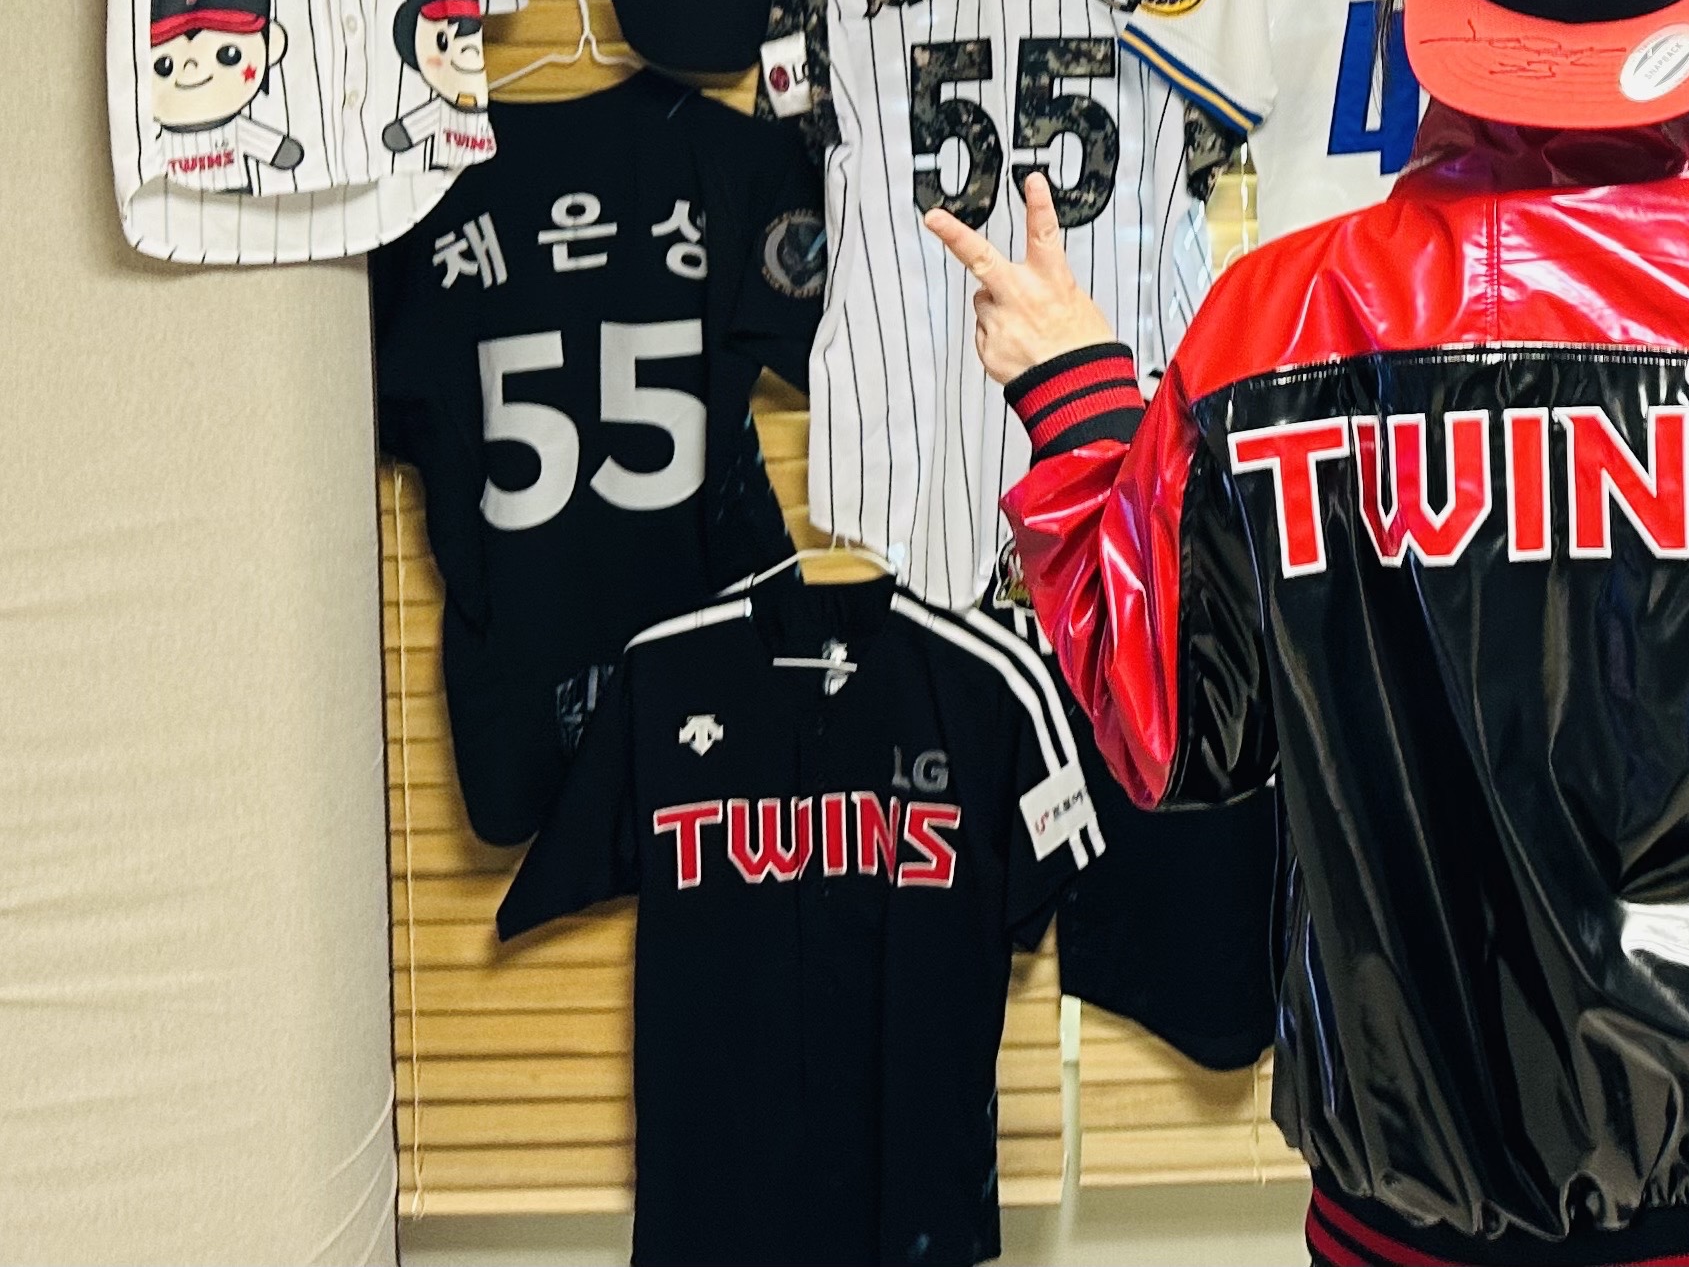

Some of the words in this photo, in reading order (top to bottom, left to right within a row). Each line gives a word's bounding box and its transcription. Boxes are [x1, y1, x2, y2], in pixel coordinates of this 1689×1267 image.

[910, 36, 1119, 231] 55
[1644, 41, 1684, 81] SNAPBACK
[478, 318, 708, 531] 55
[653, 790, 962, 891] TWINS
